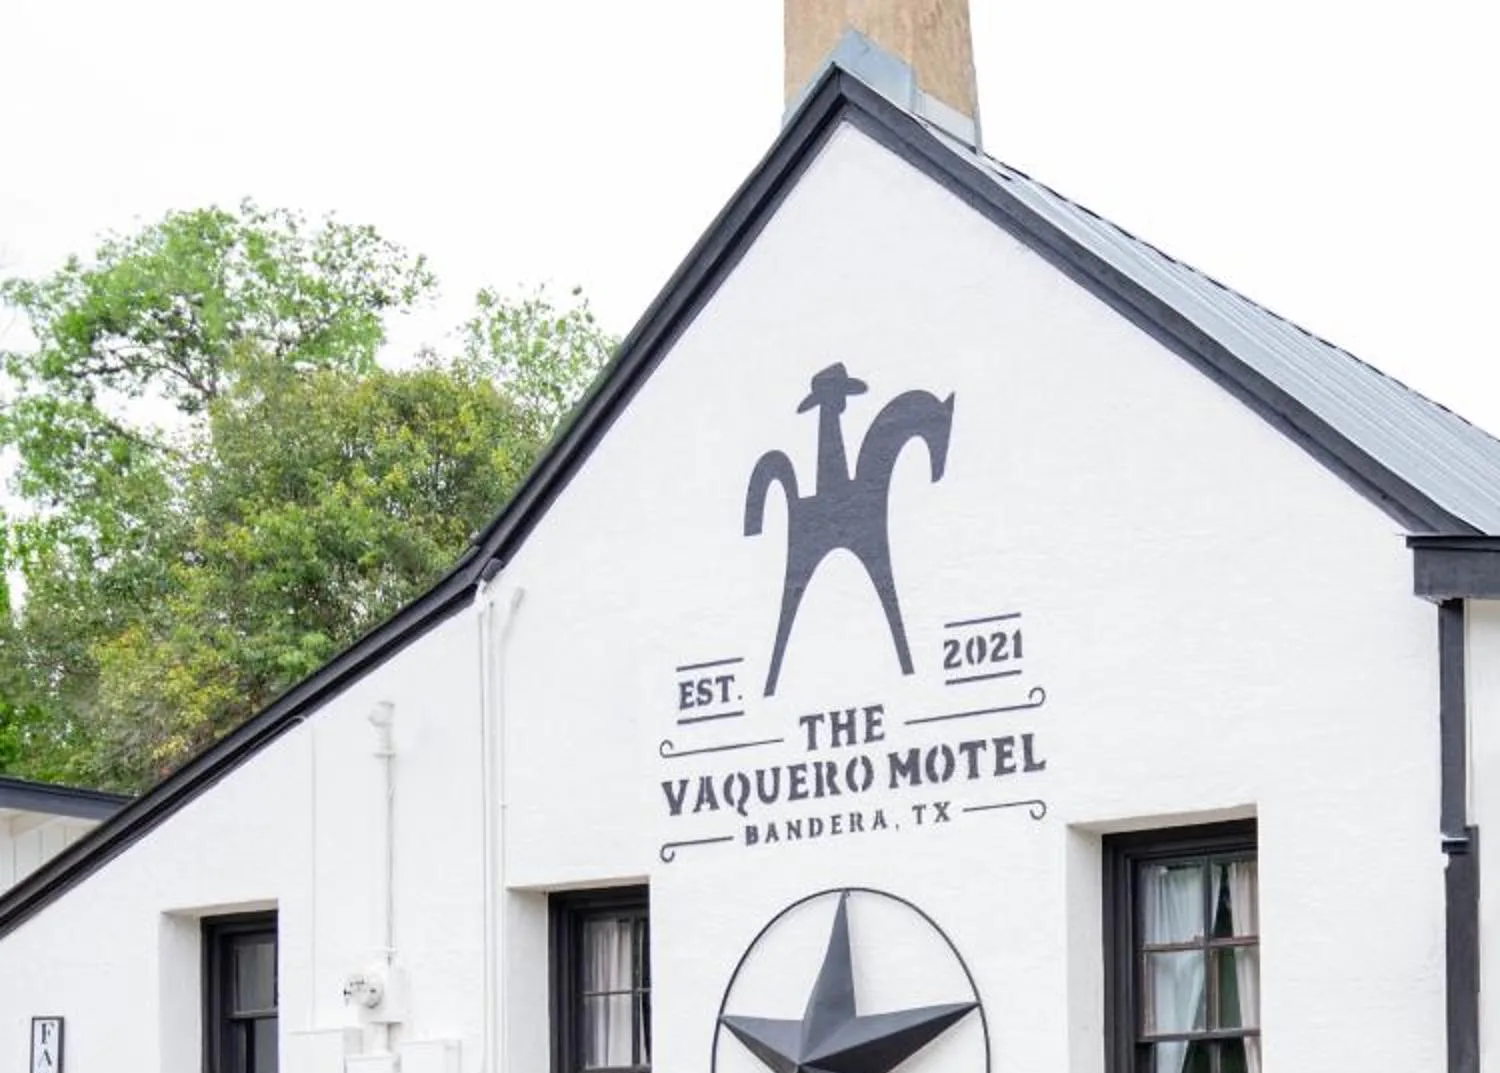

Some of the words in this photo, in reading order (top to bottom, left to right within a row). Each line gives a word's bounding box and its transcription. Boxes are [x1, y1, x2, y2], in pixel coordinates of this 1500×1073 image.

[679, 674, 743, 711] EST.
[943, 629, 1024, 670] 2021
[799, 704, 886, 751] THE
[660, 755, 875, 817] VAQUERO
[888, 732, 1047, 789] MOTEL
[912, 801, 952, 825] TX
